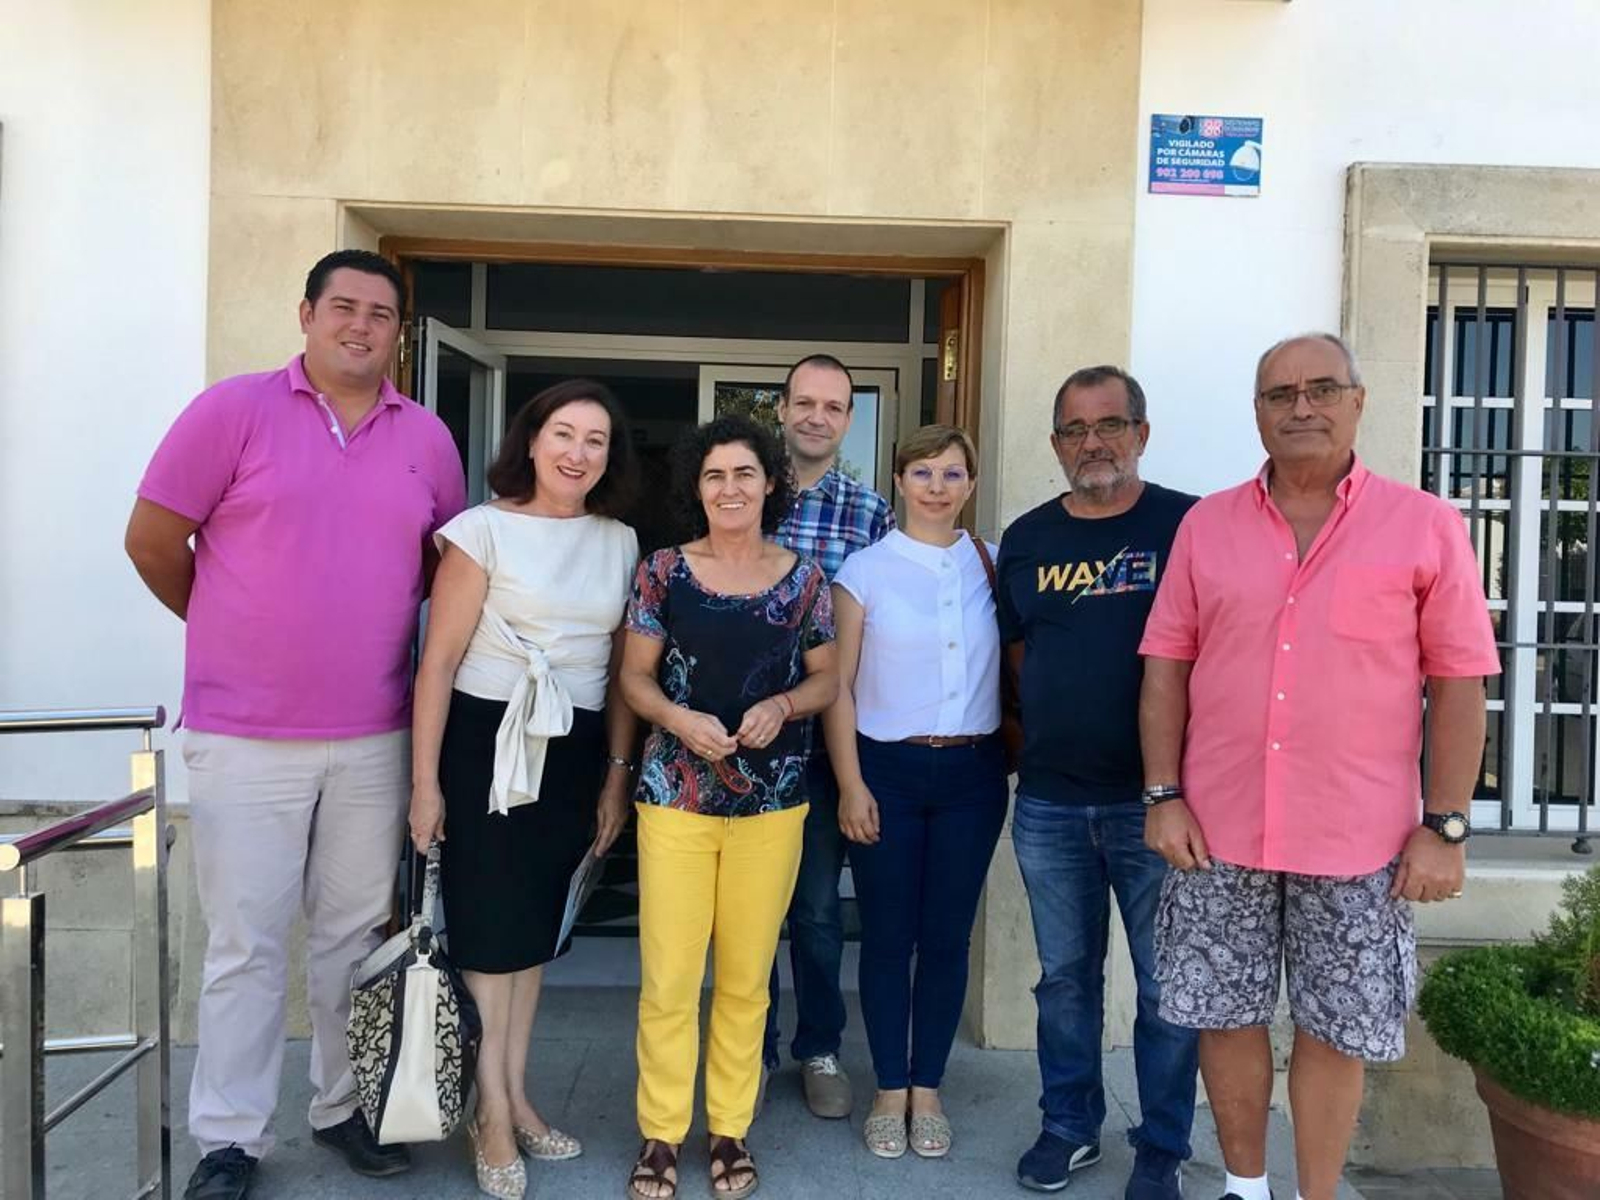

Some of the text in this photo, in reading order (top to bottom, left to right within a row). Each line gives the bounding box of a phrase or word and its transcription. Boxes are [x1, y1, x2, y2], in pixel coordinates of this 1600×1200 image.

[1169, 140, 1215, 148] VIGILADO
[1157, 148, 1225, 158] POR CÁMARAS
[1156, 157, 1225, 167] DE SEGURIDAD
[1038, 553, 1156, 594] WAVE
